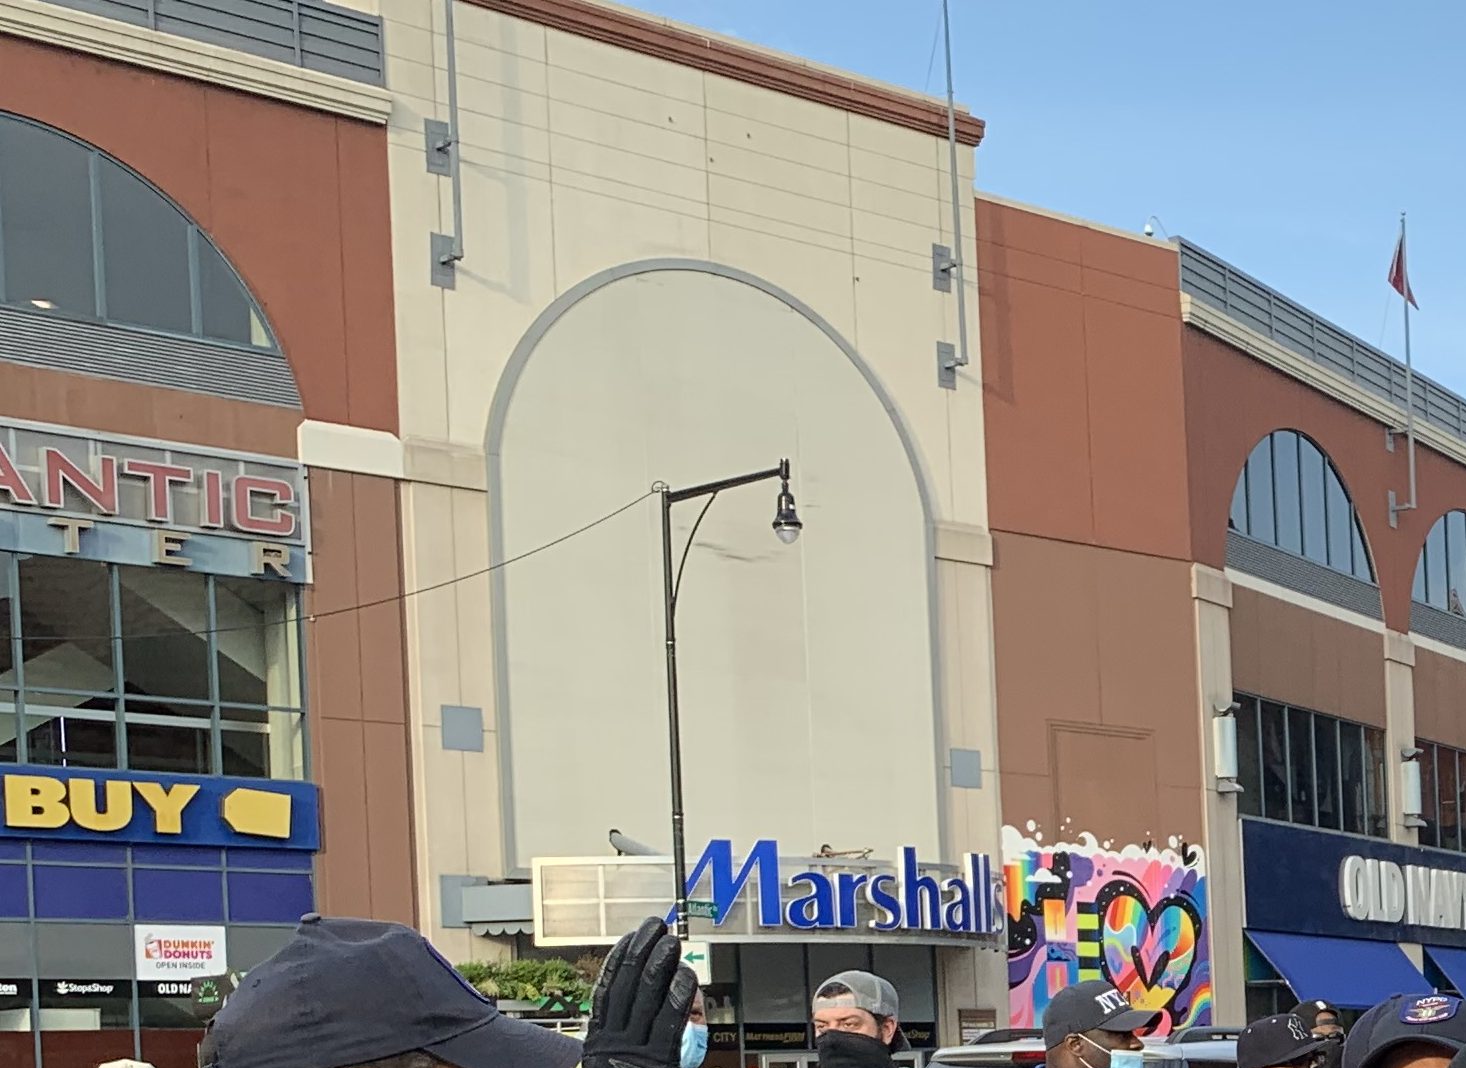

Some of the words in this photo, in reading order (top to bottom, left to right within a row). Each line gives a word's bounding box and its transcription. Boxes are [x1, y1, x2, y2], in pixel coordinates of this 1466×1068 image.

[4, 774, 201, 835] BUY
[664, 839, 1005, 932] Marshalls
[1340, 855, 1405, 922] OLD
[163, 939, 214, 950] DUNKIN'
[163, 950, 213, 960] DONUTS
[156, 961, 178, 969] OPEN
[179, 961, 206, 970] INSIDE
[69, 983, 114, 995] Stop&Shop
[157, 983, 178, 995] OLD
[1095, 988, 1129, 1015] NY
[1416, 996, 1448, 1006] NYPD
[713, 1032, 737, 1043] CITY
